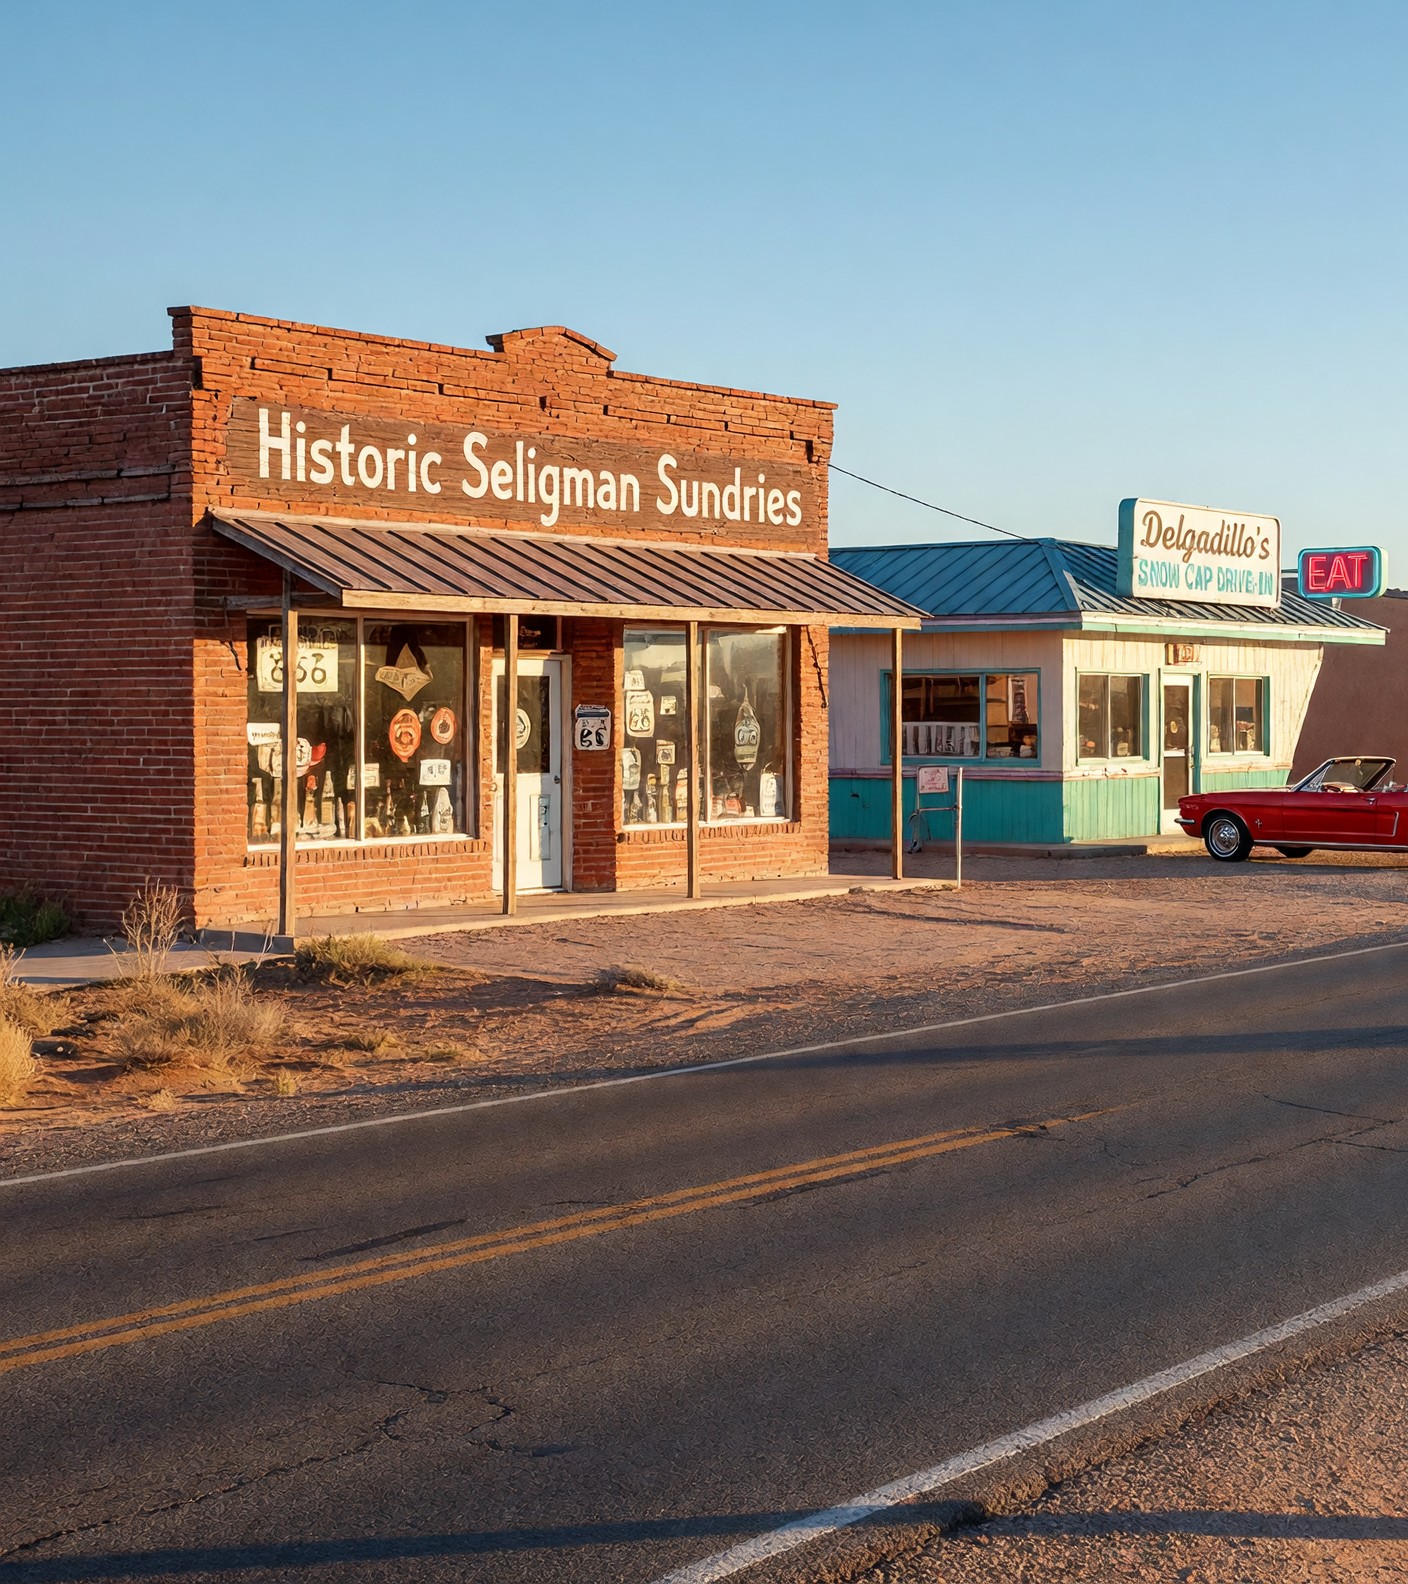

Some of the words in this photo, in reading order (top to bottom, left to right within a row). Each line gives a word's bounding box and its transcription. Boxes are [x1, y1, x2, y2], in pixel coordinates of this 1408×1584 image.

[258, 407, 443, 495] Historic
[461, 431, 641, 527] Seligman
[656, 453, 802, 527] Sundries
[1140, 510, 1270, 563] Delgadillo's
[1138, 559, 1180, 588] SNOW
[1185, 563, 1213, 591] CAP
[1307, 553, 1368, 592] EAT
